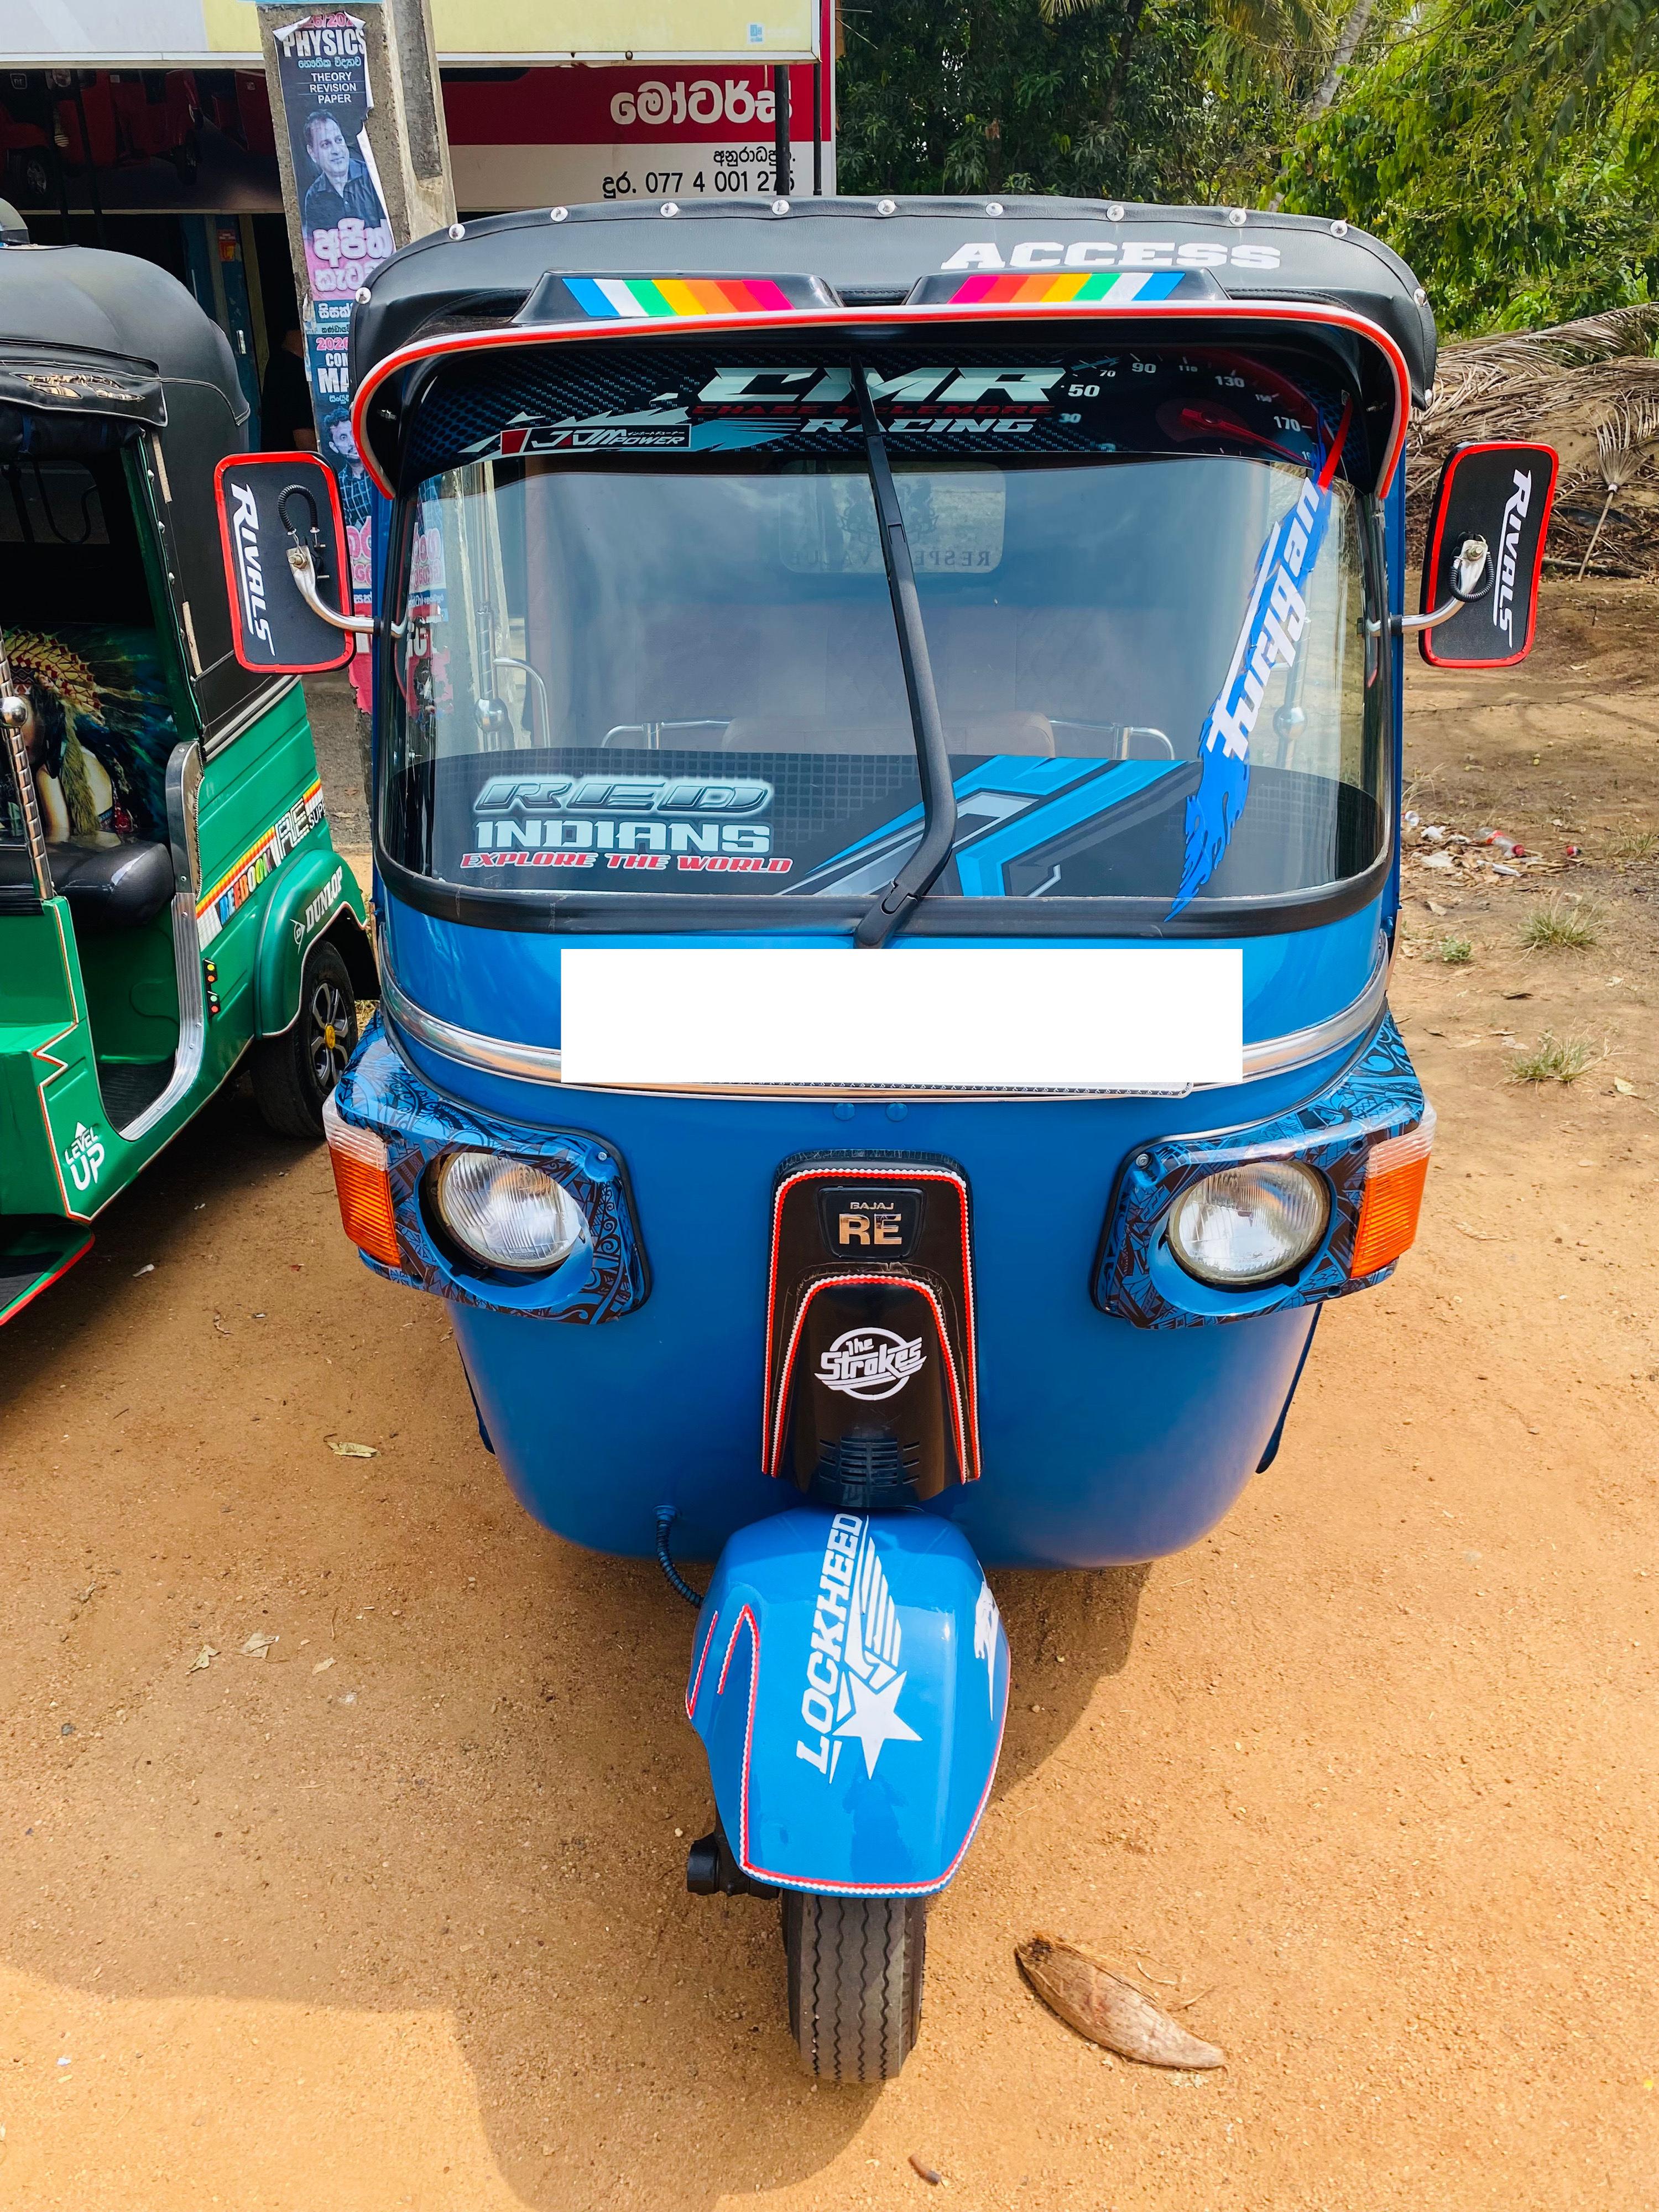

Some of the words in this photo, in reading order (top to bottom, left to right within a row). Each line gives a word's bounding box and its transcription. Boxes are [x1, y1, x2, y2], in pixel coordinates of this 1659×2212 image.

[283, 29, 364, 57] PHYSICS
[311, 72, 352, 82] THEORY
[309, 83, 357, 93] REVISION
[317, 94, 352, 104] PAPER
[645, 171, 683, 193] 077
[693, 171, 706, 192] 4
[714, 171, 748, 192] 001
[941, 242, 1281, 270] ACCESS
[1131, 363, 1156, 373] 90
[698, 367, 1066, 401] CMR
[1067, 384, 1100, 398] 50
[1215, 375, 1245, 388] 130
[692, 405, 822, 414] CHASE
[1058, 413, 1082, 424] 30
[800, 419, 1037, 432] RACING
[1274, 416, 1301, 432] 170
[608, 436, 685, 445] POWER
[473, 778, 773, 816] RED
[476, 820, 770, 853] INDIANS
[461, 852, 598, 869] EXPLORE
[605, 852, 671, 870] THE
[676, 855, 794, 874] WORLD
[305, 865, 343, 933] DUNLOP
[65, 1126, 99, 1165] LEVEL
[70, 1142, 105, 1191] UP
[850, 1202, 894, 1210] BAJAJ
[838, 1213, 902, 1245] RE
[846, 1338, 874, 1355] The
[815, 1337, 927, 1381] Strokes
[796, 1512, 864, 1775] LOCKHEED
